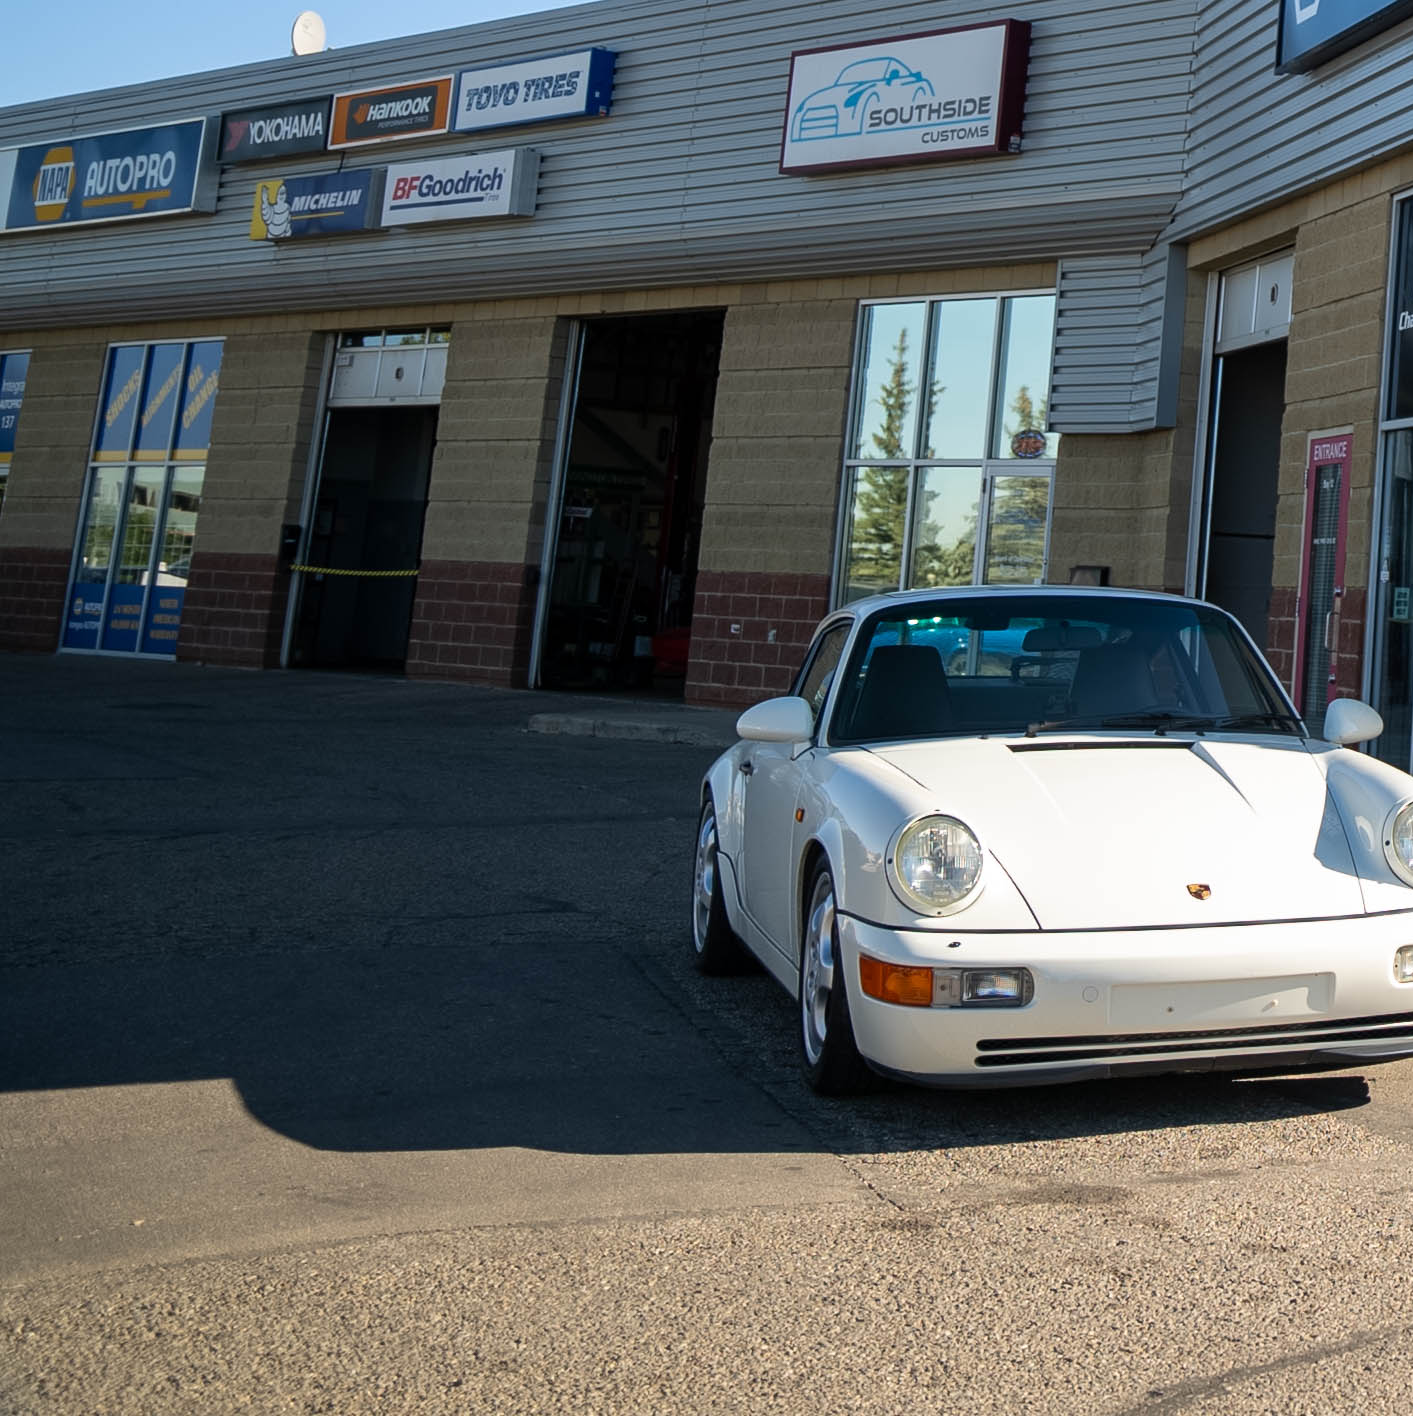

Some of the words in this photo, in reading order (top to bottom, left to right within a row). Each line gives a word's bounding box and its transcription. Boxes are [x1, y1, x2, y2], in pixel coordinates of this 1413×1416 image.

[466, 81, 520, 112] TOYO
[523, 71, 580, 102] TIRES
[249, 112, 323, 144] YOKOHAMA
[869, 96, 992, 128] SOUTHSIDE
[921, 126, 989, 144] CUSTOMS
[37, 163, 73, 204] NAPA
[84, 151, 176, 197] AUTOPRO
[392, 167, 503, 201] BFGoodrich
[291, 189, 362, 212] MICHELIN
[1314, 441, 1347, 461] ENTRANCE
